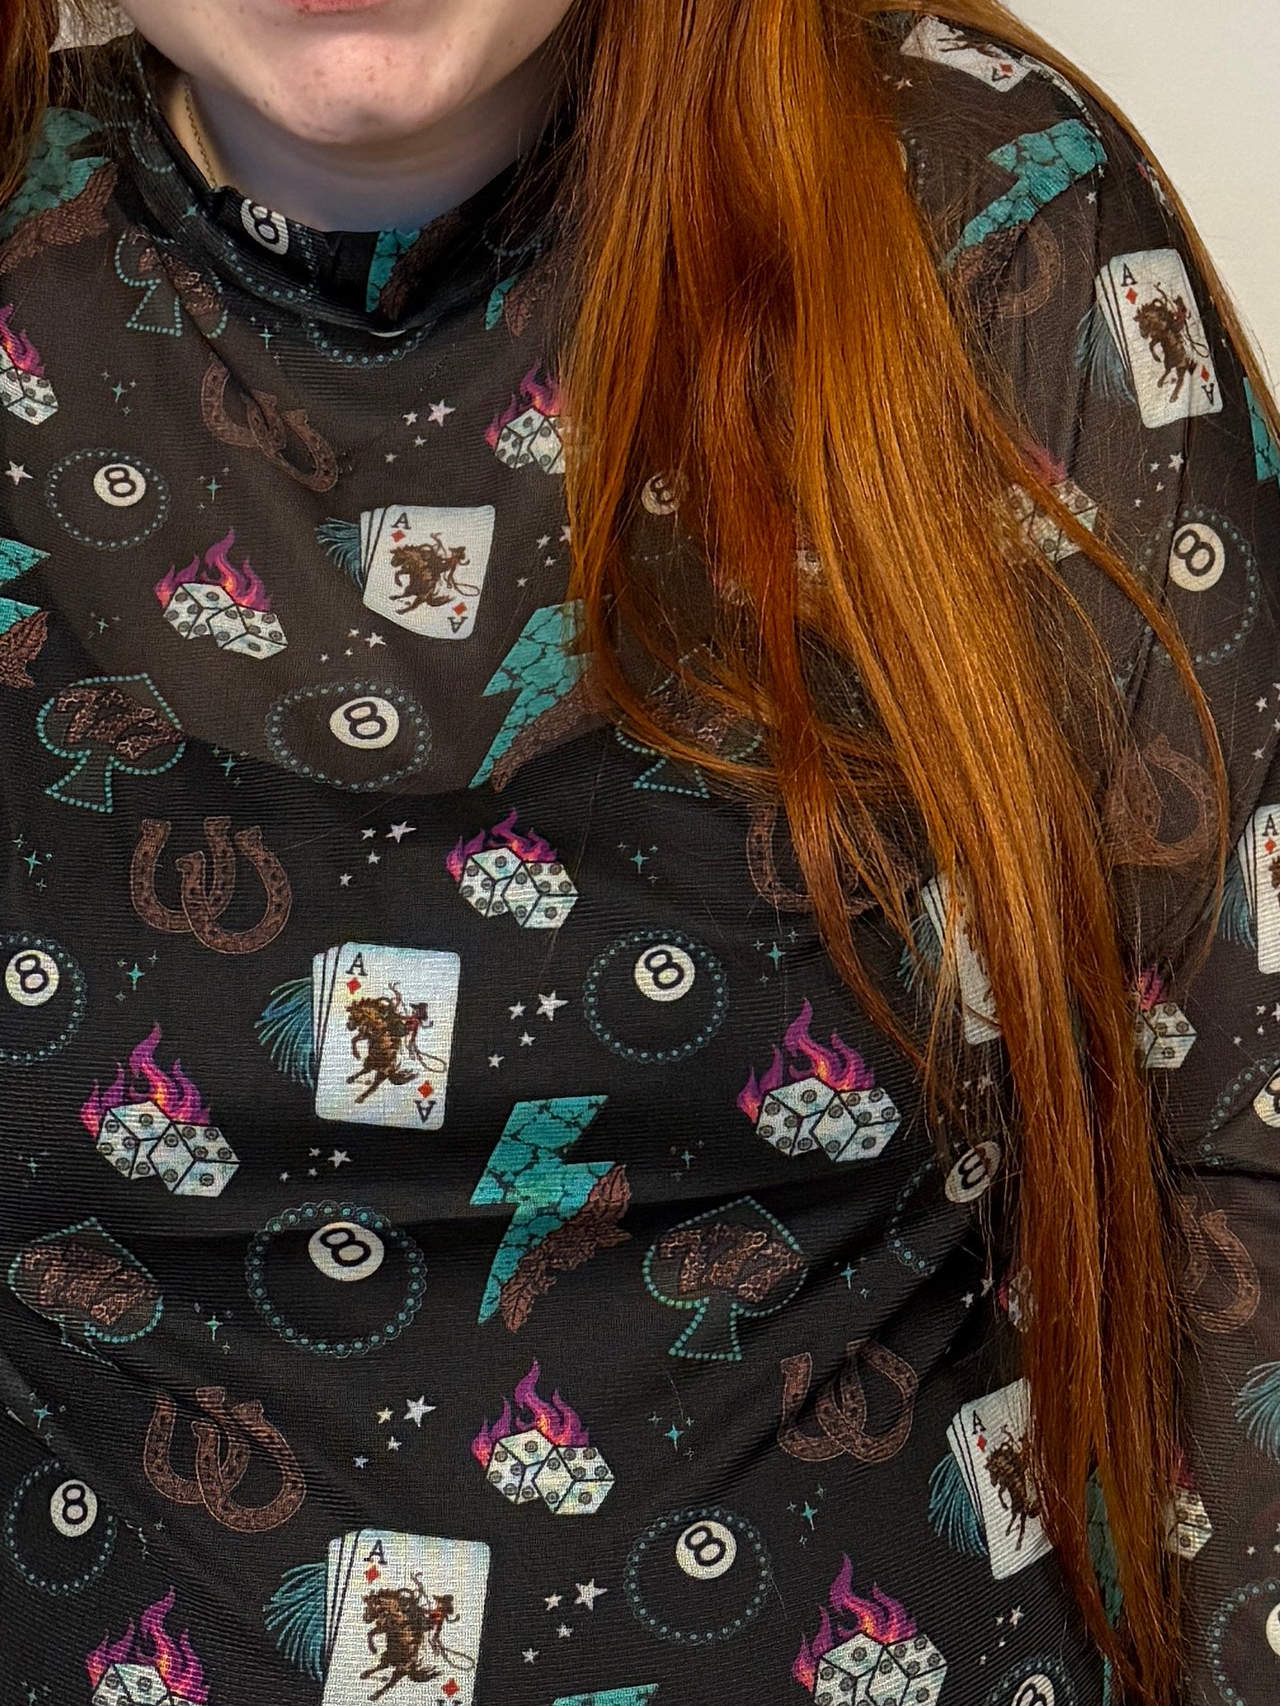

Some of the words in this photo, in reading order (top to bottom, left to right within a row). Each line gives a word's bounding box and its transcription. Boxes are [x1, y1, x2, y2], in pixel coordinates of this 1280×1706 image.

[252, 204, 278, 242] 8
[1121, 263, 1138, 286] A
[1201, 383, 1214, 406] A
[105, 466, 137, 497] 8
[393, 512, 411, 530] A
[1172, 528, 1216, 578] 8
[447, 616, 468, 633] A
[343, 700, 388, 740] 8
[1262, 813, 1279, 836] A
[19, 955, 50, 992] 8
[345, 952, 368, 976] A
[644, 949, 684, 990] 8
[414, 1100, 437, 1122] A
[319, 1228, 372, 1268] 8
[971, 1411, 986, 1434] A
[62, 1485, 89, 1526] 8
[363, 1540, 387, 1565] A
[684, 1524, 726, 1567] 8
